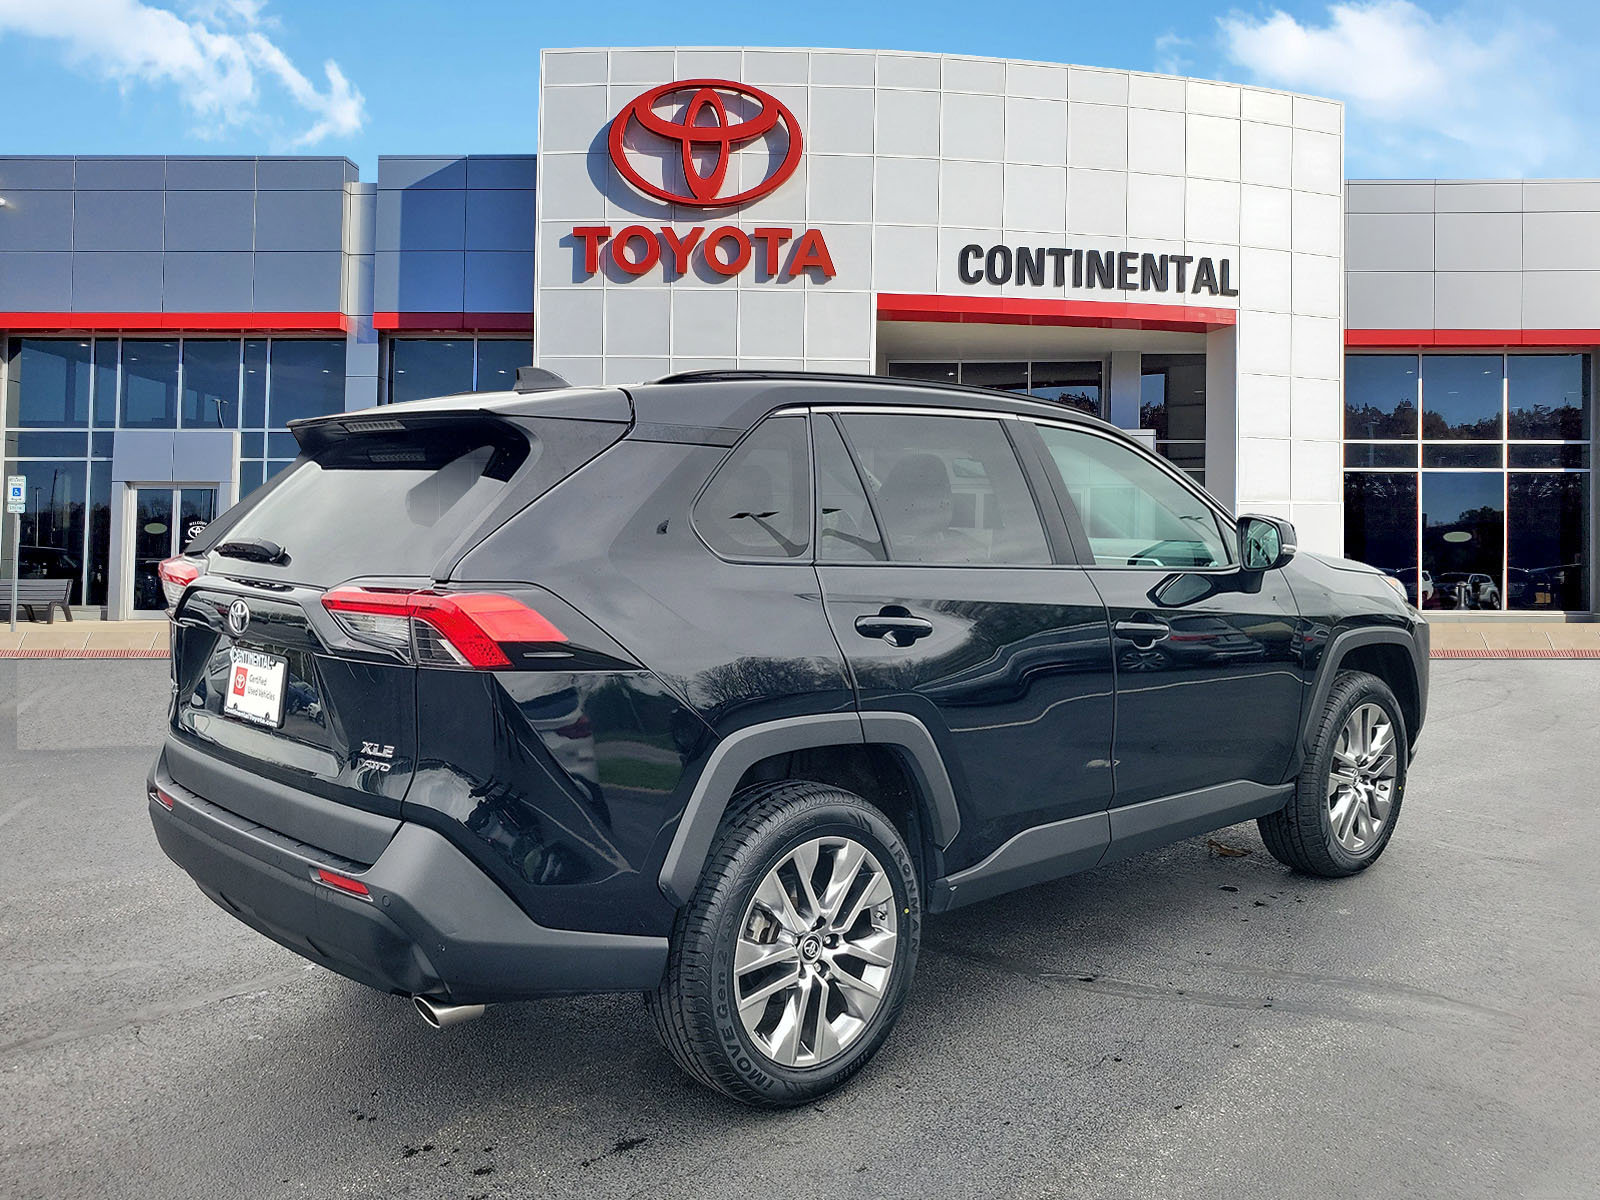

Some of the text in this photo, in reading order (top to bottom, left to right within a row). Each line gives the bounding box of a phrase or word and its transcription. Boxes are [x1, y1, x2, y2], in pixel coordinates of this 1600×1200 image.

[572, 225, 836, 276] TOYOTA
[958, 244, 1239, 297] CONTINENTAL
[230, 645, 273, 671] CONTINENTAL
[247, 686, 276, 701] Used Vehicles
[249, 674, 267, 687] Certified
[360, 741, 395, 758] XLE
[361, 759, 391, 772] AWD
[889, 840, 920, 953] IRONMAN
[716, 971, 729, 1020] Gen
